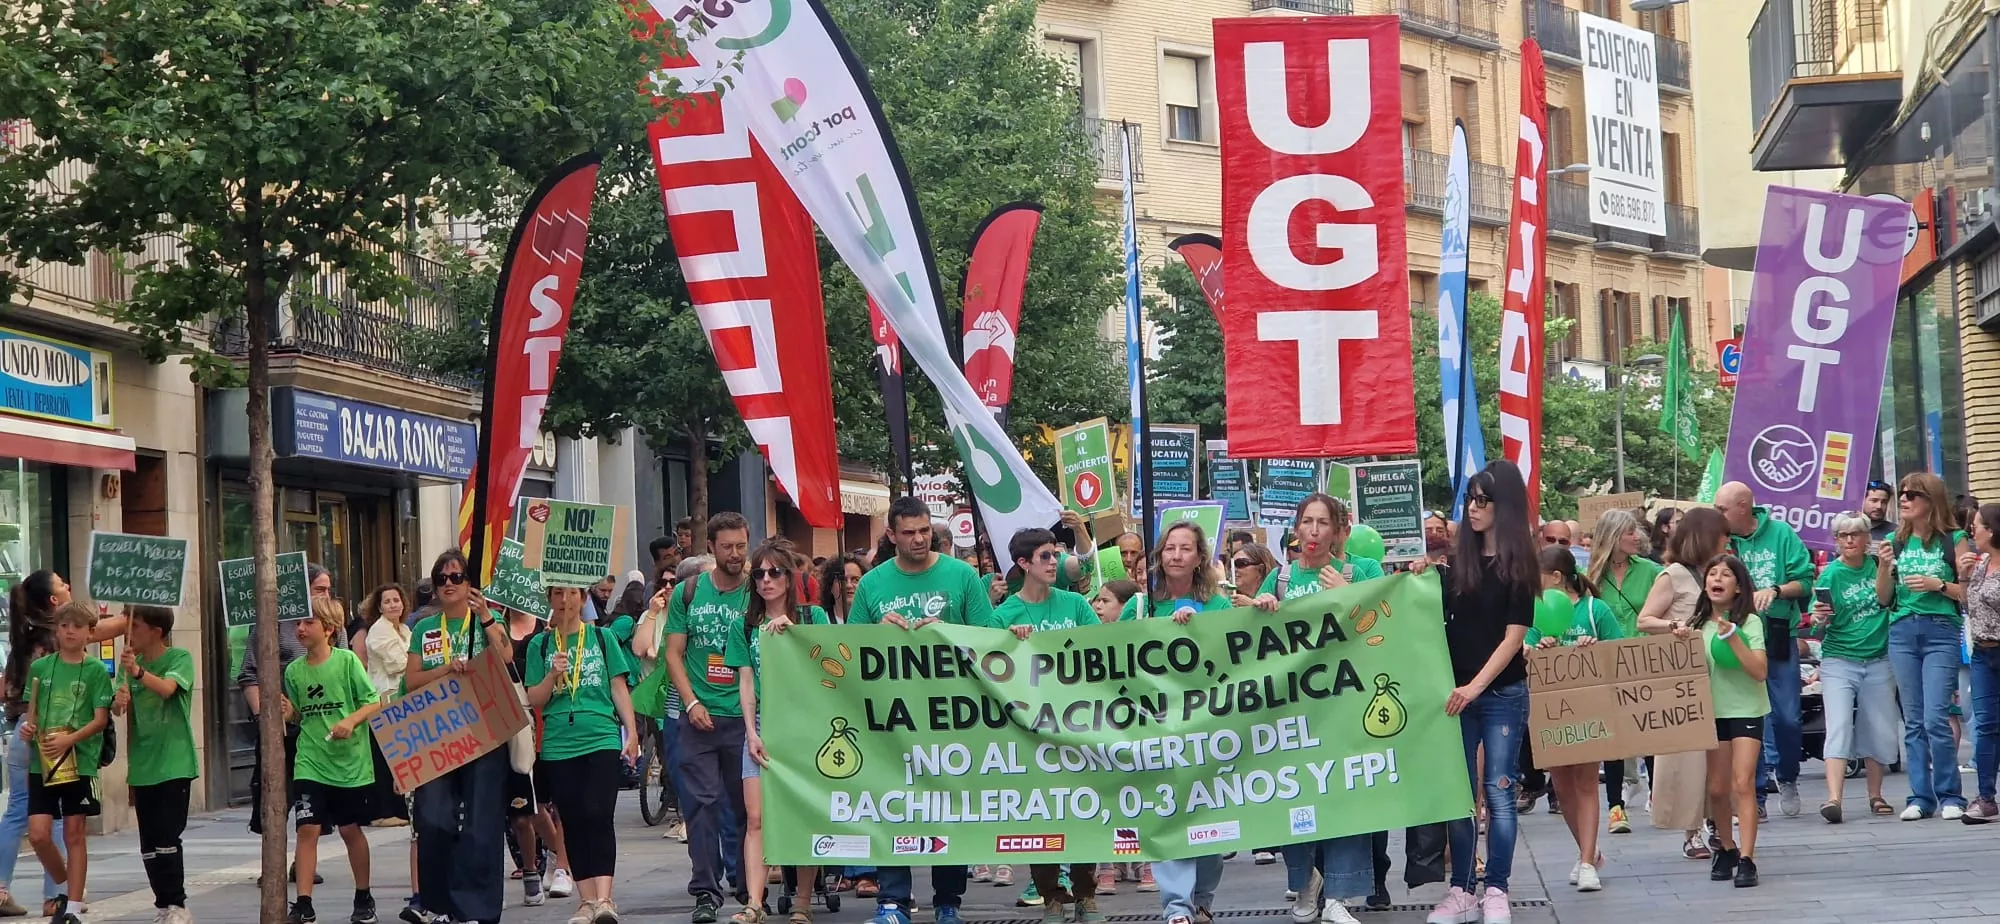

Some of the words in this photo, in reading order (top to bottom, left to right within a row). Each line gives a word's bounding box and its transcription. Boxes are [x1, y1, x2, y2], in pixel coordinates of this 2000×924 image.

[1586, 25, 1652, 83] EDIFICIO
[1615, 77, 1634, 117] EN
[1591, 114, 1655, 179] VENTA
[1610, 193, 1657, 224] 686.596.872
[1243, 38, 1379, 426] UGT
[1786, 202, 1865, 413] UGT
[1, 340, 40, 378] UNDO
[44, 348, 83, 387] MOVIL
[308, 410, 329, 421] COCINA
[297, 432, 324, 442] JUGUETES
[340, 406, 399, 463] BAZAR
[401, 418, 445, 470] RONG
[1074, 432, 1088, 442] NO
[297, 443, 323, 453] LIMPIEZA
[1076, 446, 1088, 457] AL
[1151, 451, 1189, 459] UCATIVA
[1064, 456, 1108, 474] CONCIERTO
[1267, 458, 1315, 469] EDUCATIVA
[1370, 472, 1406, 482] HUELGA
[1363, 484, 1414, 495] EDUCATIVA
[564, 507, 596, 533] NO!
[1182, 509, 1199, 519] NO
[546, 533, 559, 546] AL
[559, 534, 609, 550] CONCIERTO
[545, 546, 594, 563] EDUCATIVO
[595, 551, 607, 564] EN
[107, 566, 122, 577] DE
[130, 567, 173, 582] TOD@S
[542, 561, 606, 577] BACHILLERATO
[94, 584, 131, 598] PARA
[136, 588, 177, 603] TOD@S
[512, 593, 547, 615] TOD@S
[690, 603, 723, 618] ESCUELA
[879, 595, 916, 614] ESCUELA
[233, 608, 256, 621] PAR
[695, 625, 709, 633] DE
[860, 643, 1016, 683] DINERO
[1029, 637, 1216, 687] PÚBLICO,
[1226, 612, 1348, 665] PARA
[1527, 648, 1602, 689] AZCÓN,
[1615, 637, 1704, 679] ATIENDE
[864, 697, 917, 732] LA
[928, 684, 1168, 735] EDUCACIÓN
[1183, 658, 1366, 721] PÚBLICA
[1675, 679, 1697, 698] SE
[1545, 698, 1575, 721] LA
[1632, 701, 1706, 733] VENDE!
[1540, 719, 1608, 750] PÚBLICA
[903, 742, 973, 785] ¡NO
[979, 741, 1028, 776] AL
[1036, 728, 1243, 774] CONCIERTO
[1250, 714, 1321, 756] DEL
[393, 756, 423, 790] FP
[830, 786, 1113, 826] BACHILLERATO,
[1118, 782, 1177, 819] 0-3
[1186, 765, 1301, 814] AÑOS
[1305, 759, 1335, 795] Y
[1343, 748, 1400, 791] FP!
[896, 836, 917, 845] CGT
[999, 837, 1044, 850] CCOO
[1189, 830, 1210, 841] UGT
